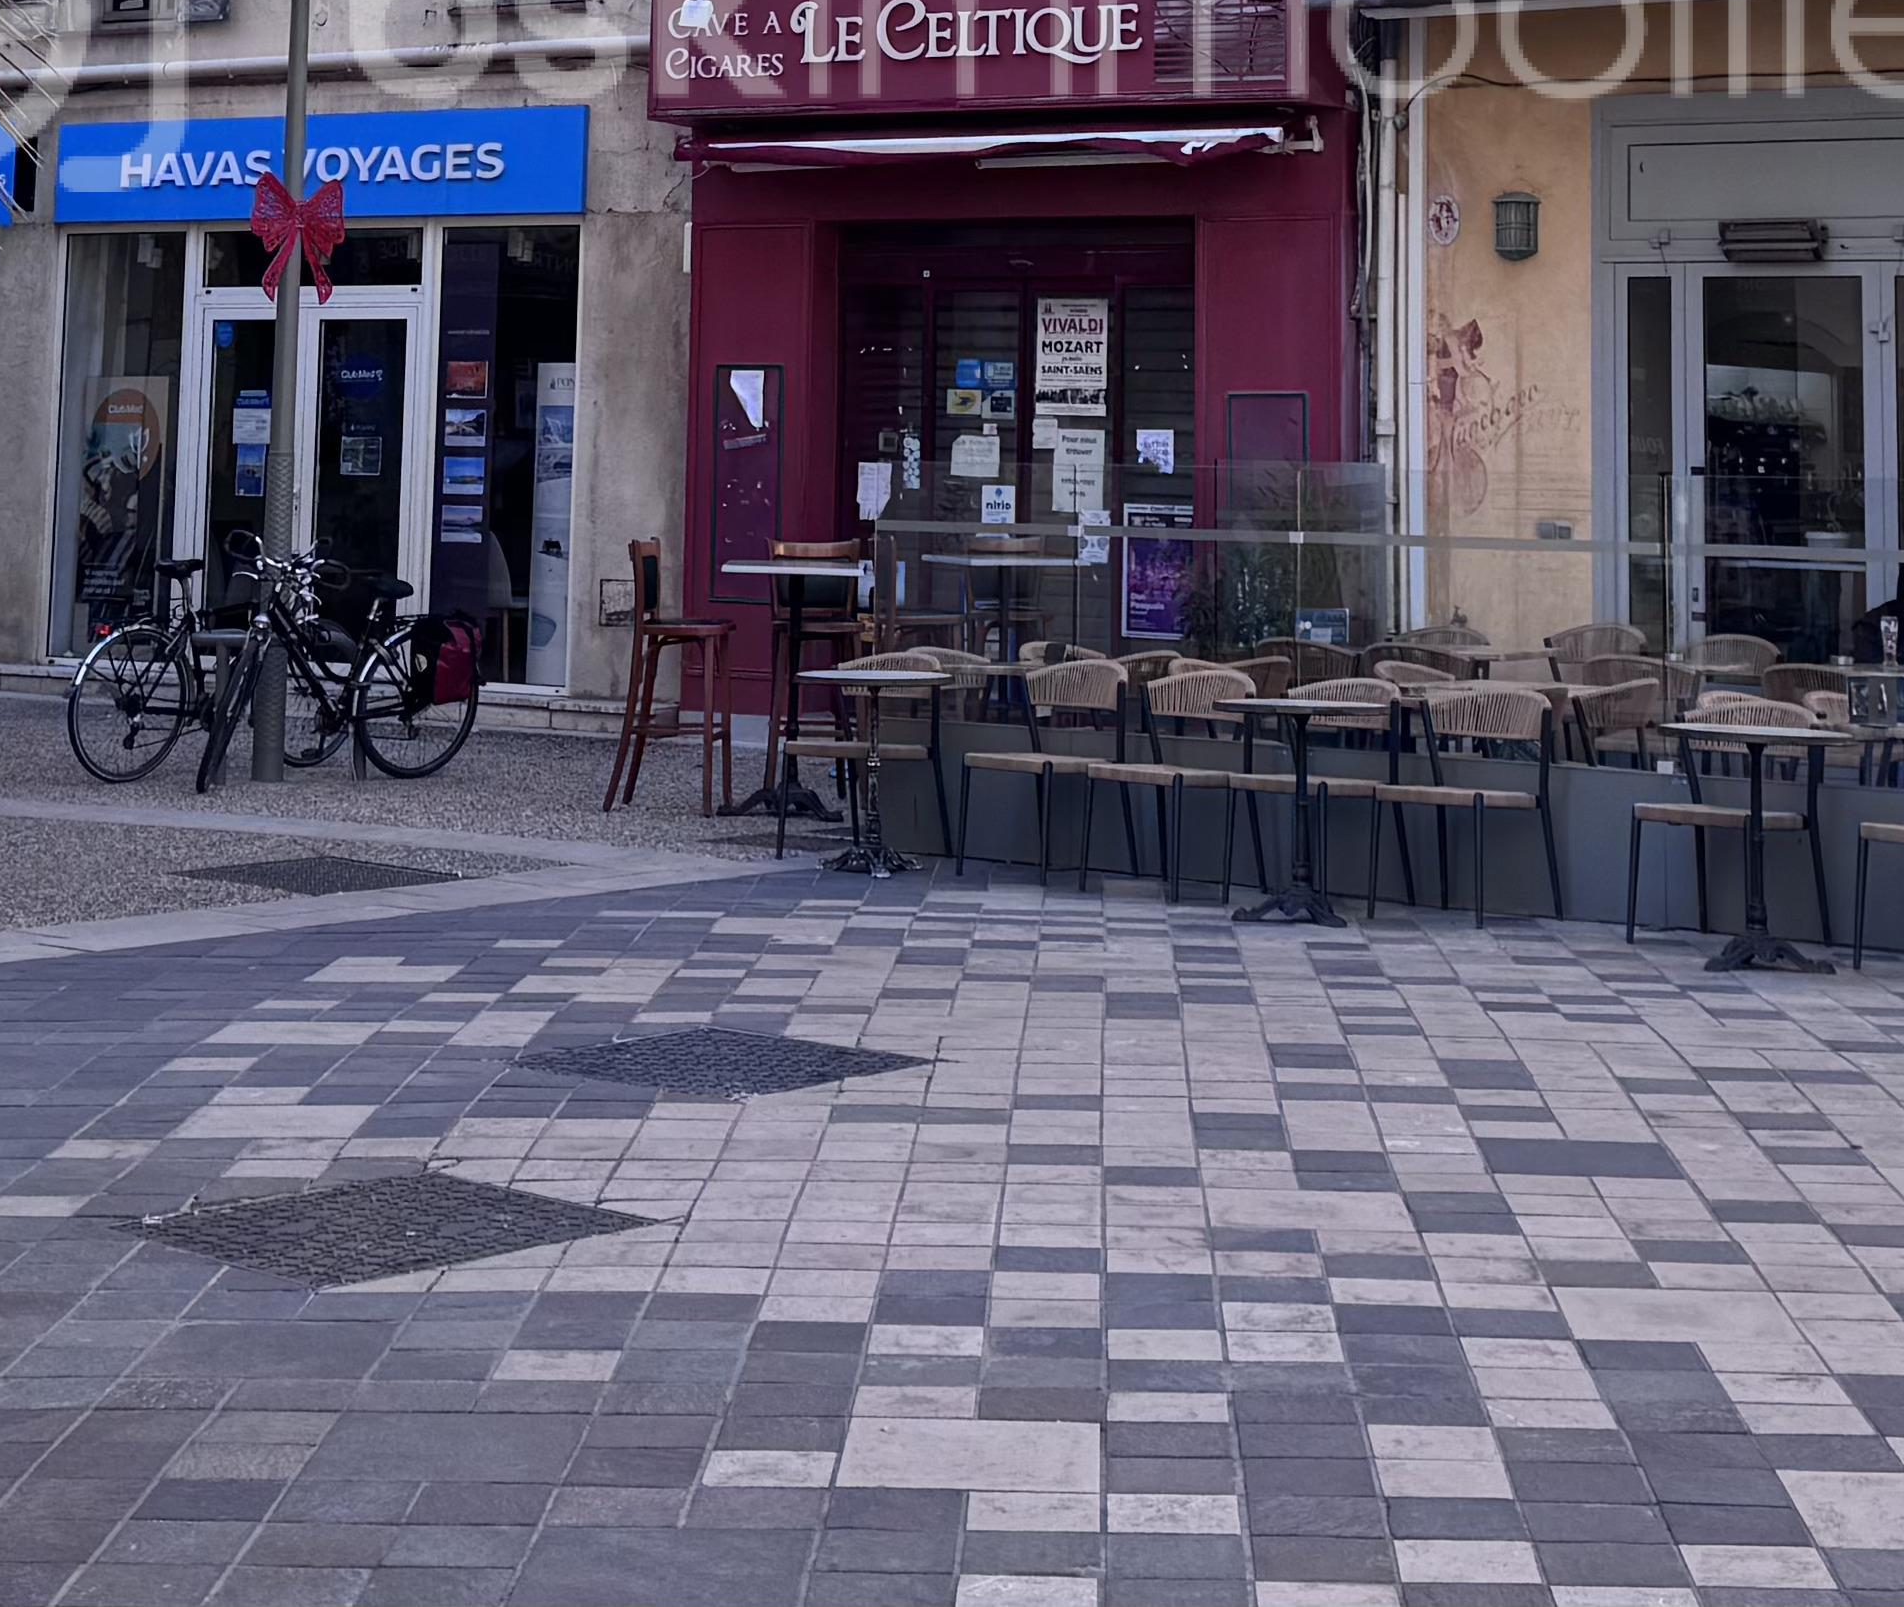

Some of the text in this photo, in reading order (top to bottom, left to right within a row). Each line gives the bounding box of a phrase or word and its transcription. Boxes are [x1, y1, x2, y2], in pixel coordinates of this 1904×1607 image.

[790, 1, 866, 64] LE
[665, 47, 784, 80] CIGARES
[120, 149, 273, 188] HAVAS
[1041, 317, 1104, 333] VIVALDI
[1041, 340, 1104, 354] MOZART
